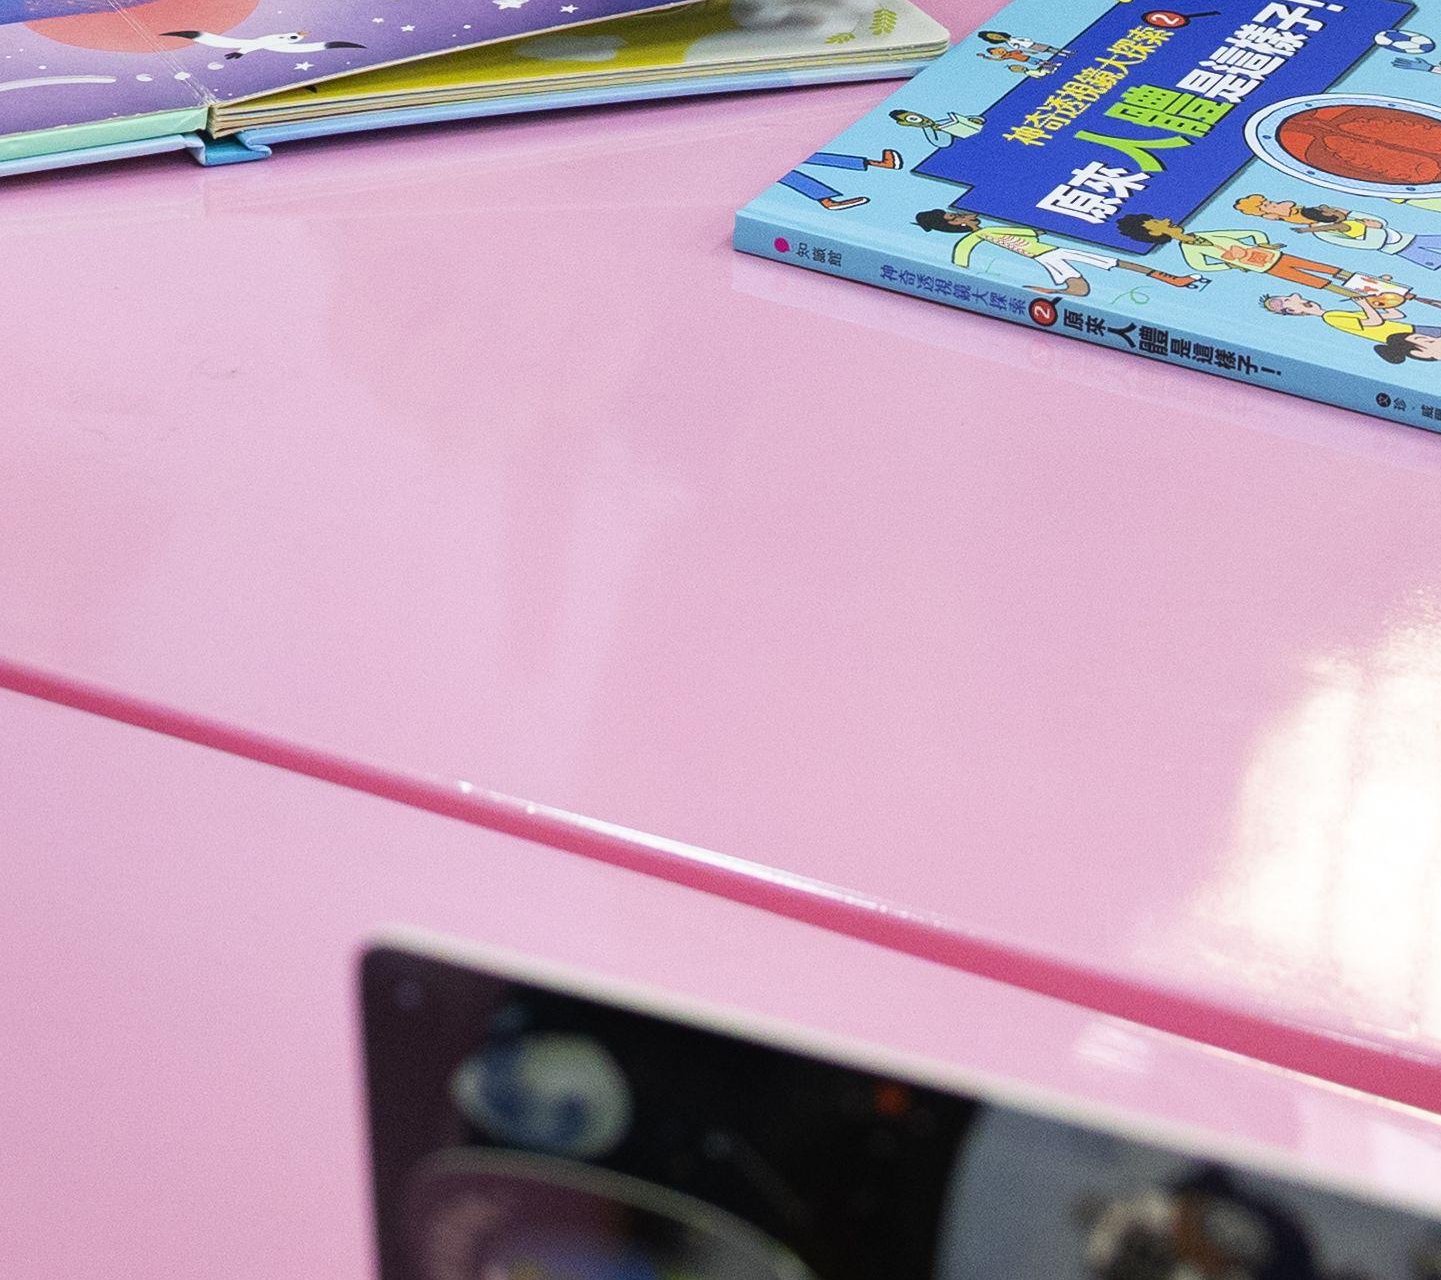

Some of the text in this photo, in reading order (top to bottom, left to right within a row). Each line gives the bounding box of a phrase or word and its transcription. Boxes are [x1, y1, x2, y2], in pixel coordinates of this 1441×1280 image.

[1002, 24, 1174, 147] 神奇透視鏡大探索
[795, 242, 842, 270] 知識館
[880, 264, 1026, 316] 神奇透視鏡大探索
